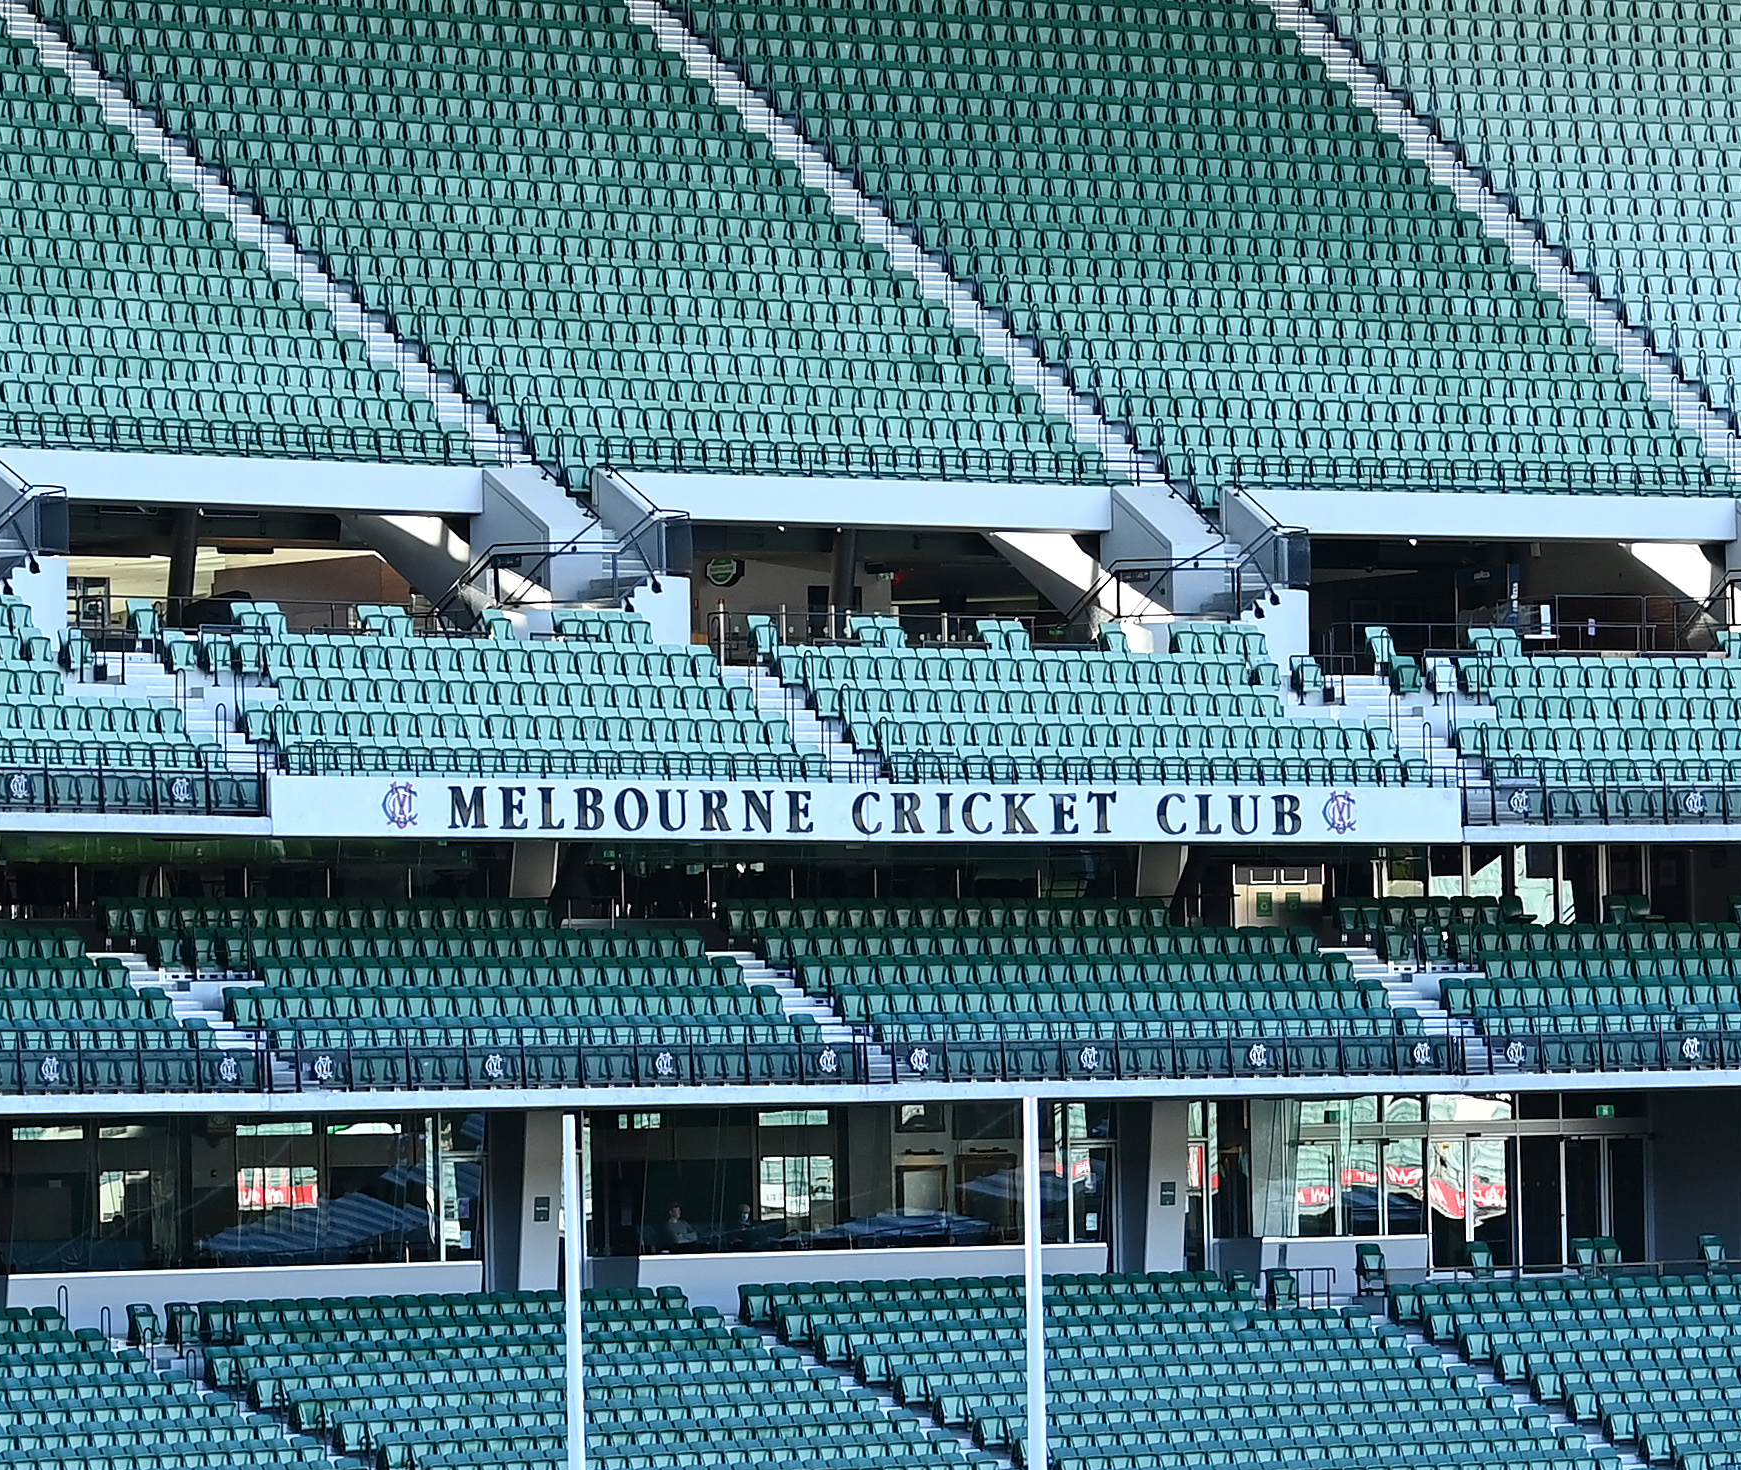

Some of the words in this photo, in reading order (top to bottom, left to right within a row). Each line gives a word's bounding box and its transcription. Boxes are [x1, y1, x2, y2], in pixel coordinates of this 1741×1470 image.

[448, 785, 814, 833] MELBOURNE
[851, 790, 1117, 835] CRICKET
[1157, 793, 1302, 836] CLUB
